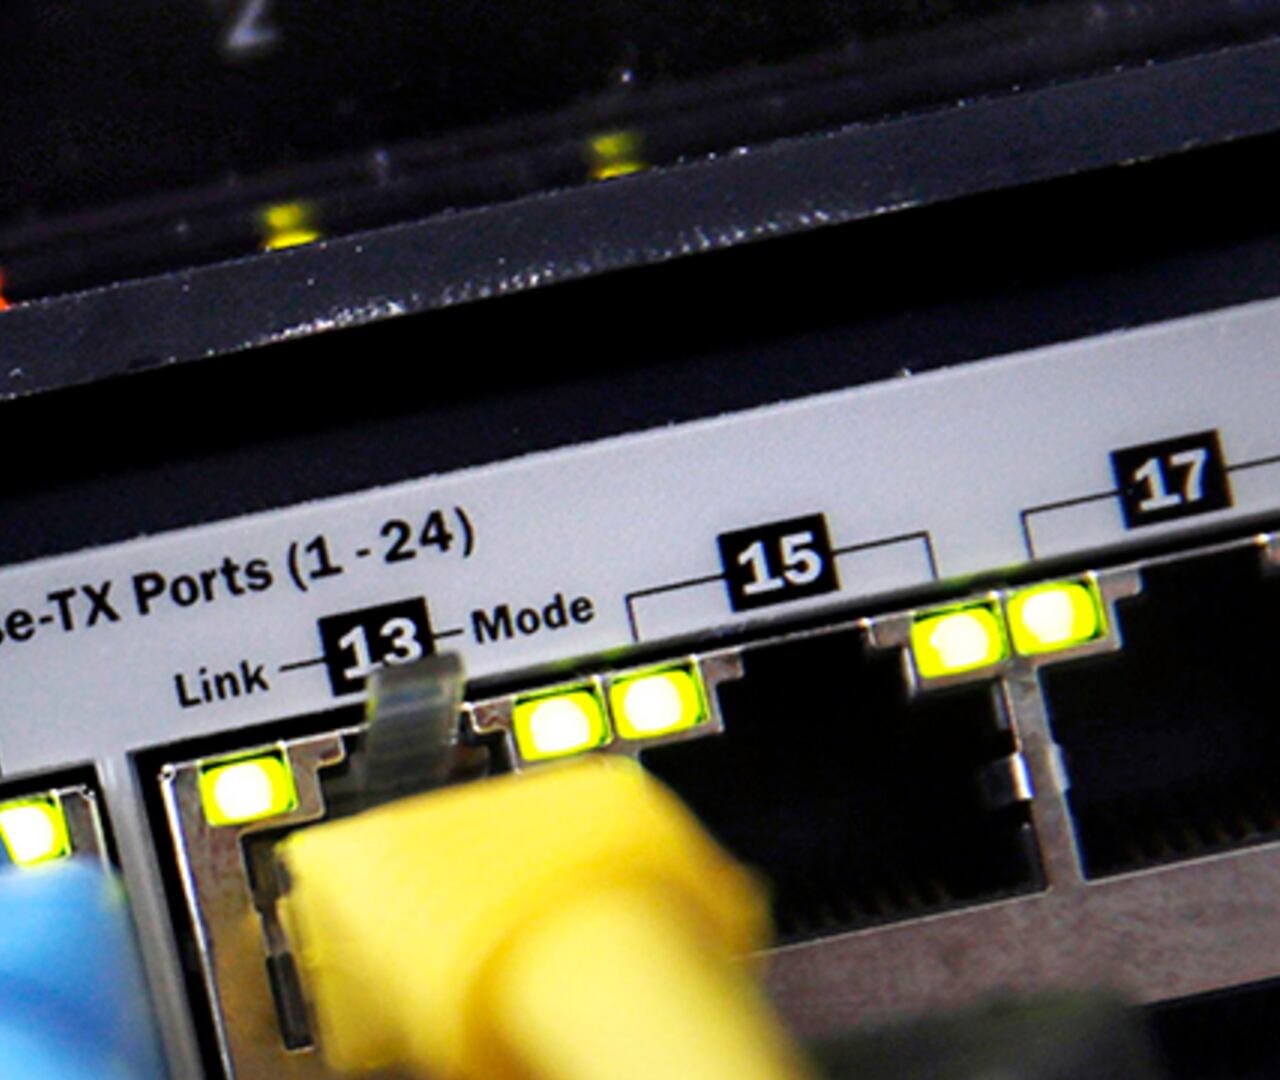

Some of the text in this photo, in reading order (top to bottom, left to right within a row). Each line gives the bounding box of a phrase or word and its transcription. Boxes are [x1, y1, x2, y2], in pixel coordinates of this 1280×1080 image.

[1133, 448, 1206, 511] 17
[130, 557, 273, 616] Ports
[738, 531, 822, 595] 15
[173, 592, 594, 709] Link 13 Mode
